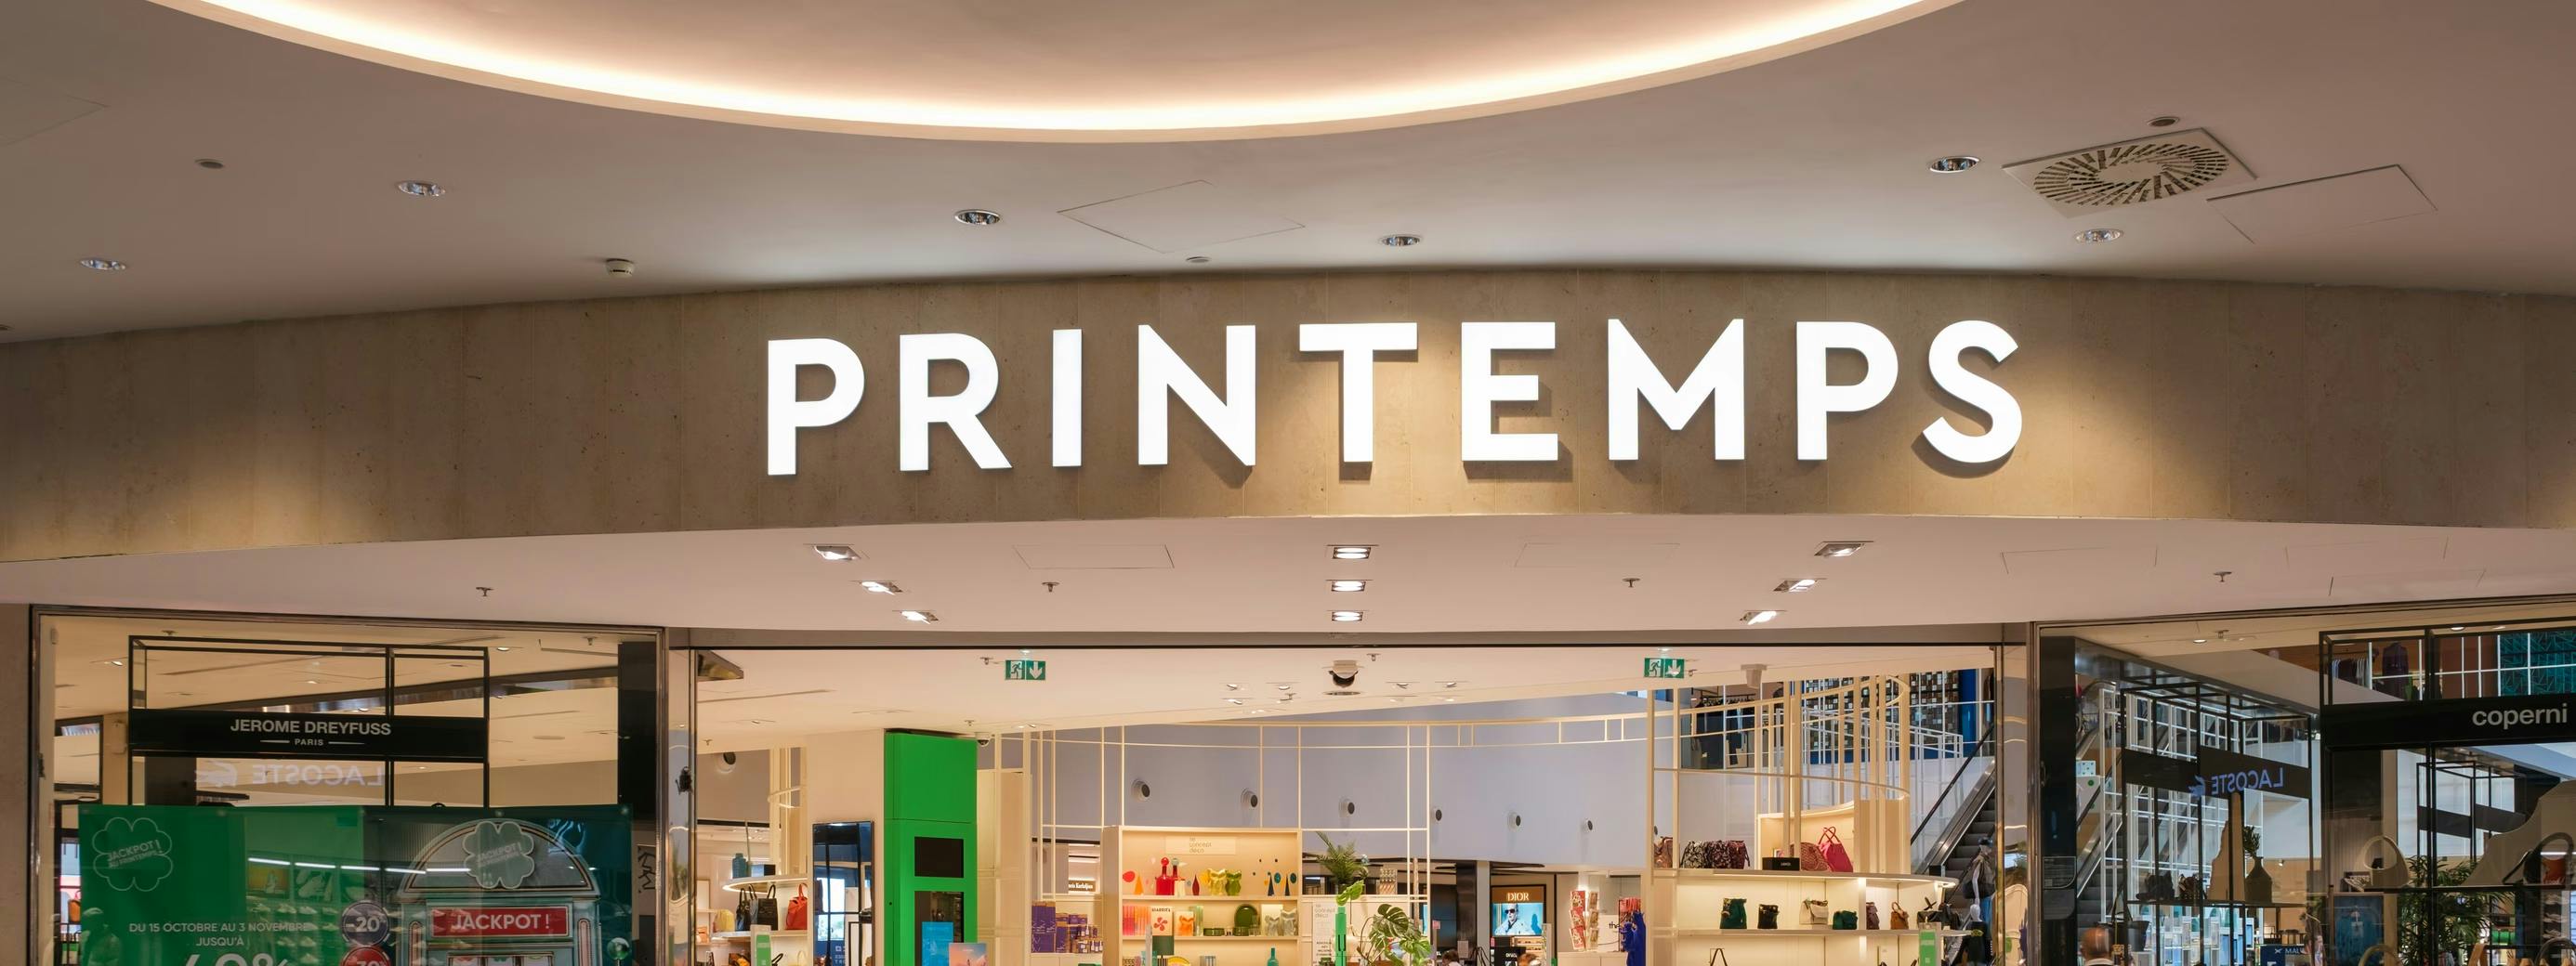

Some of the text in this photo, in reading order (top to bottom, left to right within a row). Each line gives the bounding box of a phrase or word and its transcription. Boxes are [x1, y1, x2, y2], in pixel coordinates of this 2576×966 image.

[767, 318, 2023, 476] PRINTEMPS
[2472, 702, 2568, 730] coperni
[230, 719, 391, 736] JEROME DREYFUSS
[1507, 892, 1530, 901] DIOR
[129, 923, 311, 933] DU 15 OCTOBRE AU 3 NOVEMBRE
[454, 914, 541, 930] JACKPOT
